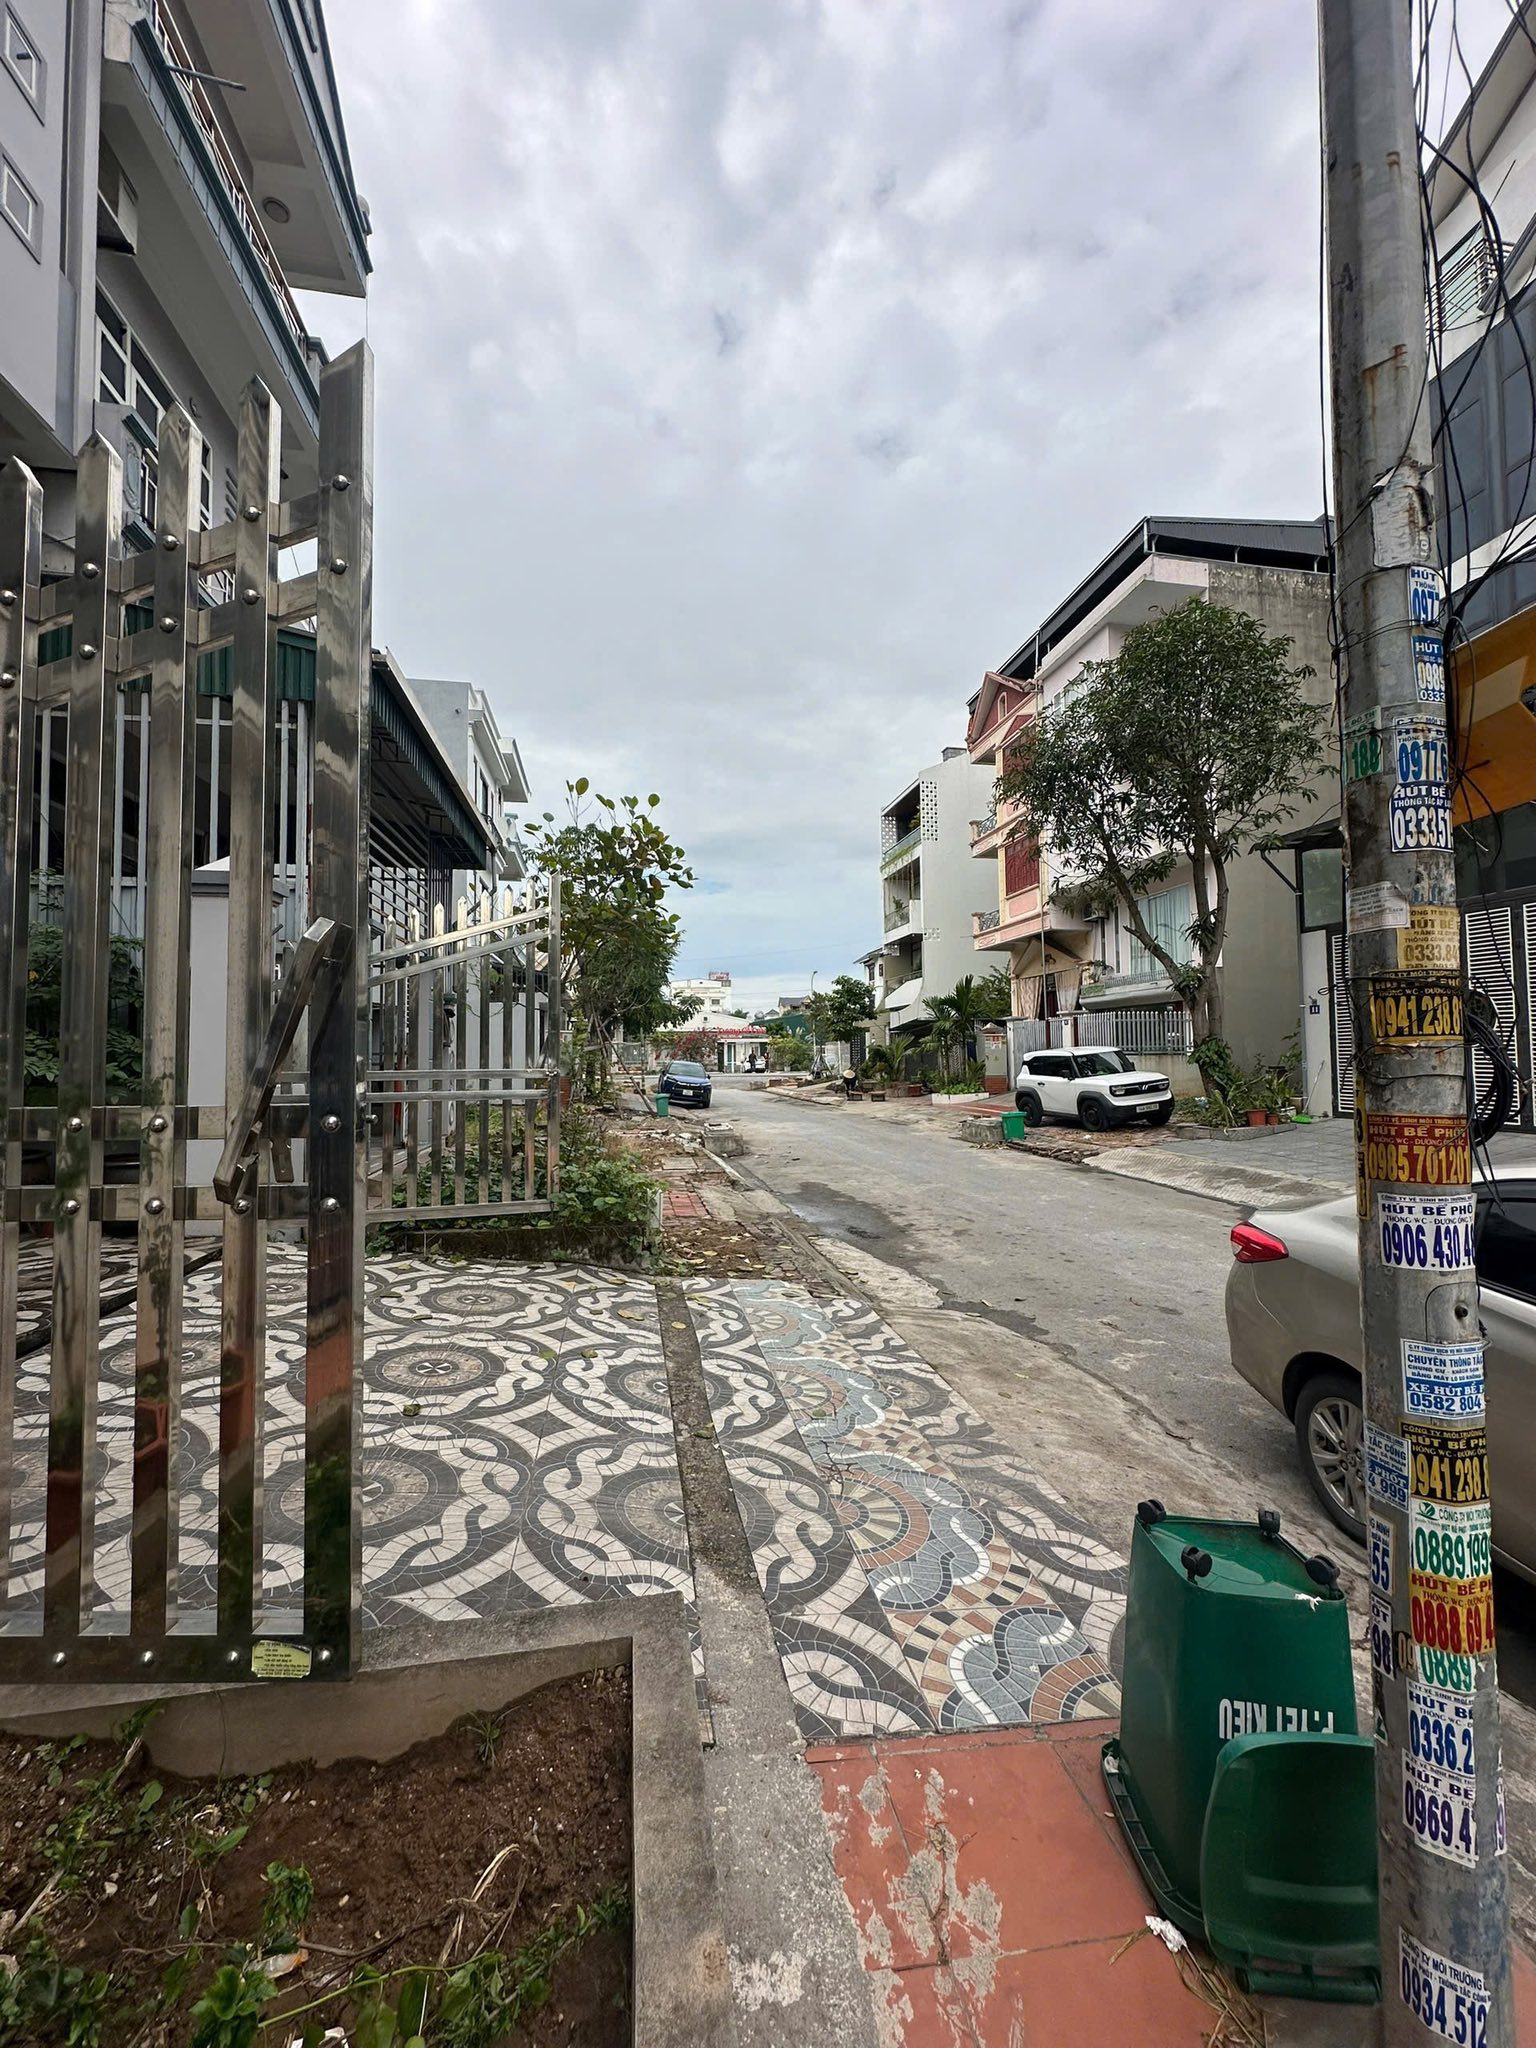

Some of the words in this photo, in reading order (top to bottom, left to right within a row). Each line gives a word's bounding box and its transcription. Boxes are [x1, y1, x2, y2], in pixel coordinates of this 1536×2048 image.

[1411, 568, 1437, 579] HÚT
[1415, 640, 1439, 654] HÚT
[1394, 784, 1428, 799] HÚT
[1394, 797, 1422, 808] THÔNG
[1375, 995, 1463, 1036] 0941.238.8
[1369, 1123, 1398, 1136] HÚT
[1382, 1202, 1415, 1215] HÚT
[1386, 1214, 1411, 1224] THÔNG
[1413, 1217, 1428, 1225] WC
[1407, 1354, 1447, 1367] CHUYÊN
[1450, 1356, 1471, 1368] THÔNG
[1407, 1364, 1433, 1372] CHUNG
[1408, 1382, 1431, 1393] XE
[1434, 1385, 1462, 1396] HÚT
[1409, 1392, 1456, 1413] 0582
[1459, 1395, 1482, 1412] 804
[1403, 1425, 1427, 1435] CÔNG
[1405, 1433, 1441, 1447] HÚT
[1438, 1448, 1452, 1458] WC
[1380, 1479, 1407, 1503] 999
[1439, 1506, 1458, 1522] CÔNG
[1415, 1526, 1491, 1580] 0889.199
[1371, 1541, 1390, 1591] 55
[1412, 1573, 1450, 1592] HÚT
[1423, 1590, 1449, 1604] THÔNG
[1409, 1689, 1447, 1712] HÚT
[1420, 1707, 1446, 1721] THÔNG
[1448, 1717, 1461, 1726] WC
[1409, 1708, 1474, 1776] 0336.2
[1405, 1760, 1442, 1788] HÚT
[1415, 1780, 1440, 1797] THÔNG
[1442, 1792, 1455, 1802] WC
[1402, 1932, 1419, 1958] CÔNG
[1421, 1950, 1430, 1967] TY
[1432, 1957, 1447, 1975] MÔI
[1449, 1966, 1482, 1991] TRƯỜNG
